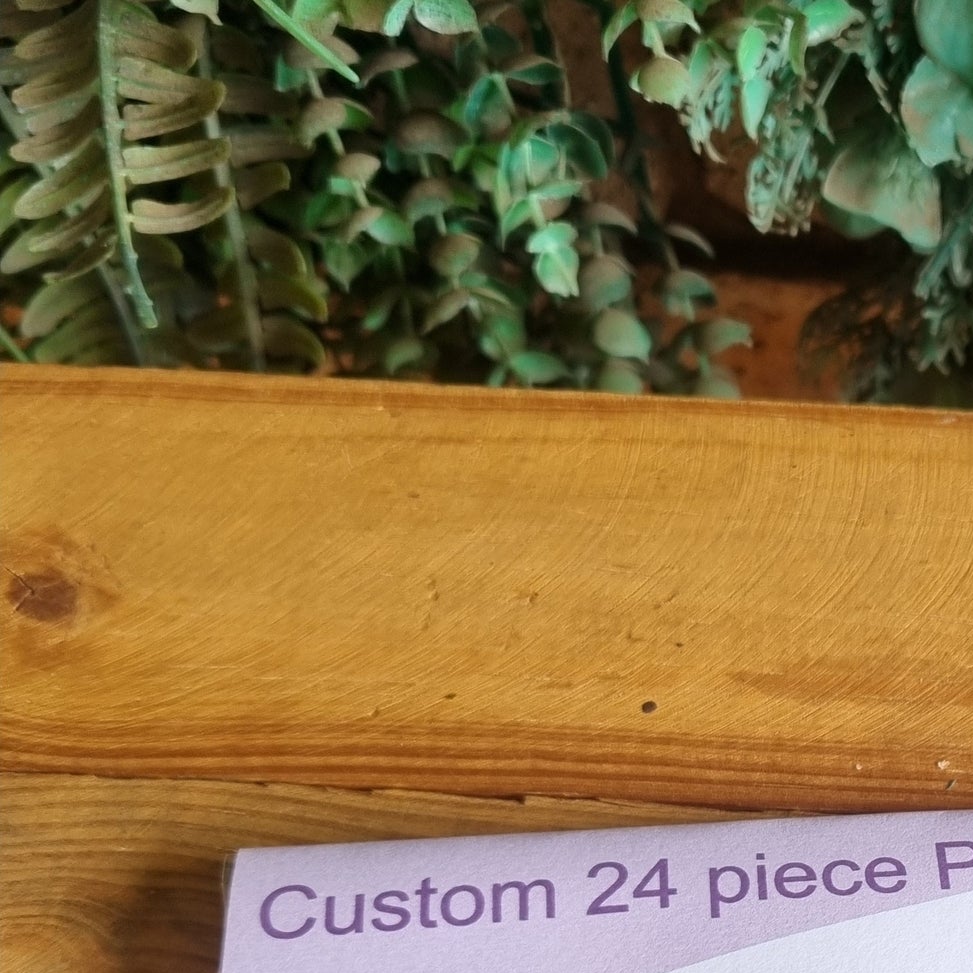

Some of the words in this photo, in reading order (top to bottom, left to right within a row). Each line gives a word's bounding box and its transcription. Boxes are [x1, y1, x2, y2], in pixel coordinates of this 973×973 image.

[259, 874, 557, 940] Custom
[586, 857, 678, 916] 24
[708, 852, 908, 919] piece
